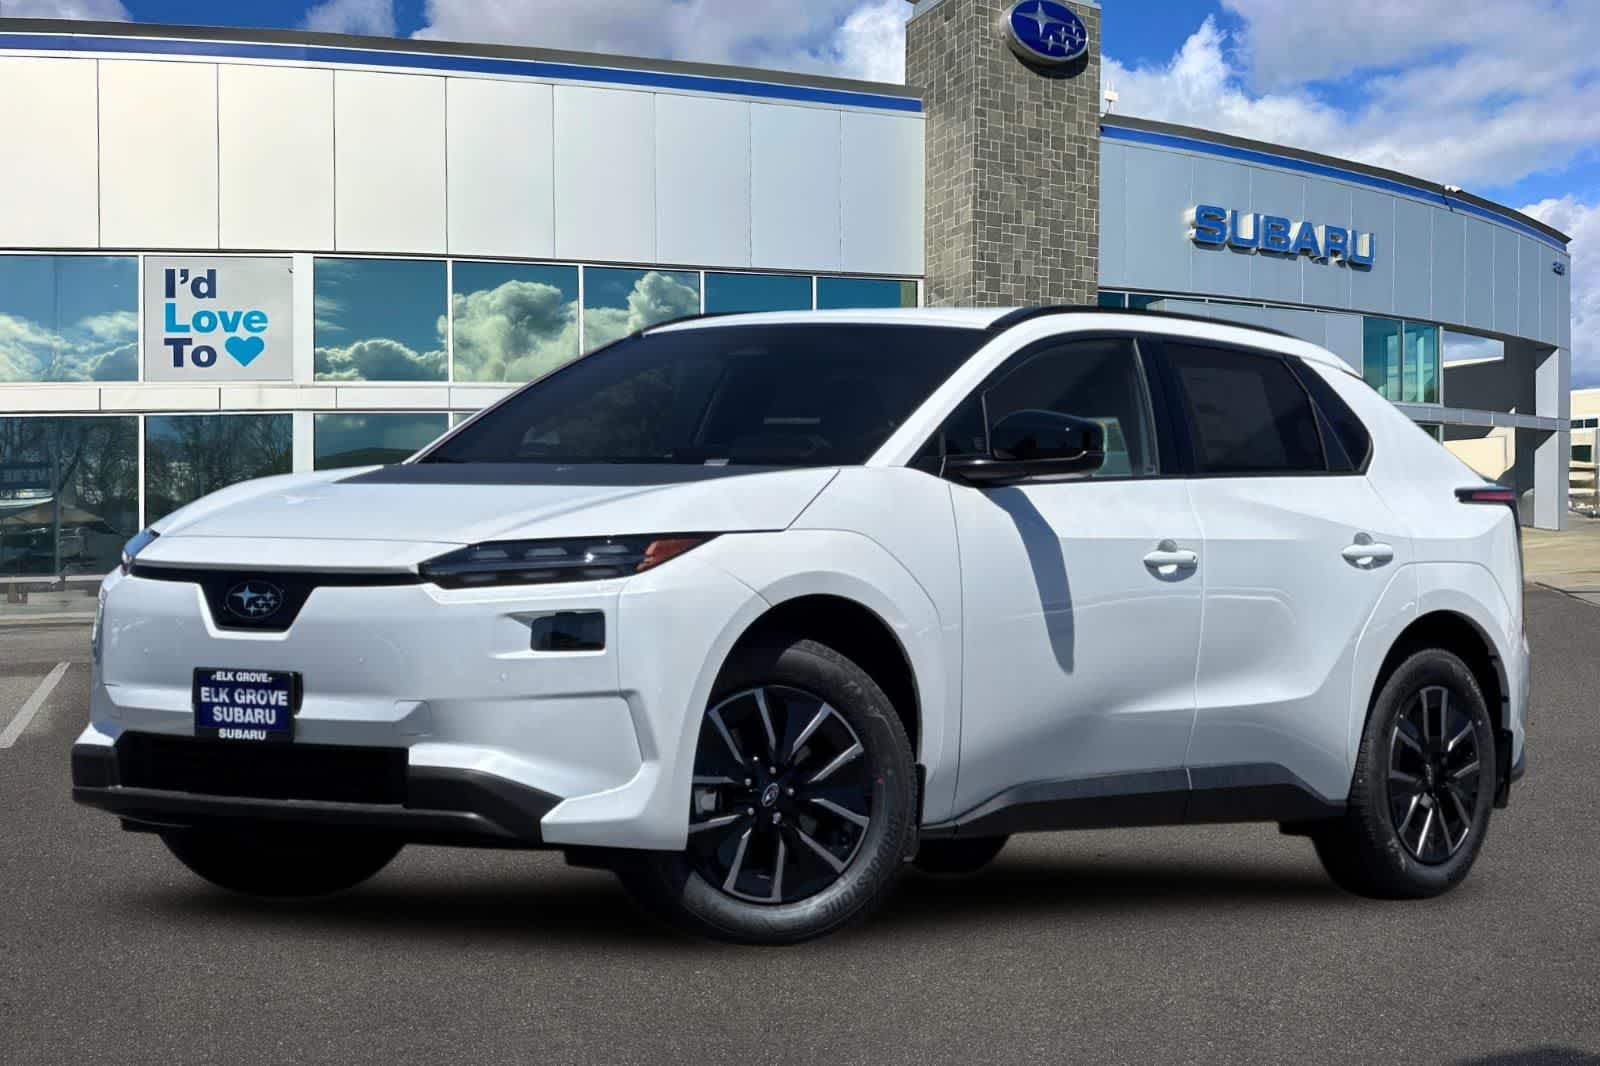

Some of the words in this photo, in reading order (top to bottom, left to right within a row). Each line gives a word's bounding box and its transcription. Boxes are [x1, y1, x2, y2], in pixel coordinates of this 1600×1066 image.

[1192, 204, 1376, 269] SUBARU
[164, 268, 217, 299] I’d
[164, 302, 268, 333] Love
[163, 337, 218, 368] To
[200, 687, 230, 703] ELK
[234, 688, 288, 706] GROVE
[212, 705, 276, 725] SUBARU
[218, 728, 266, 740] SUBARU
